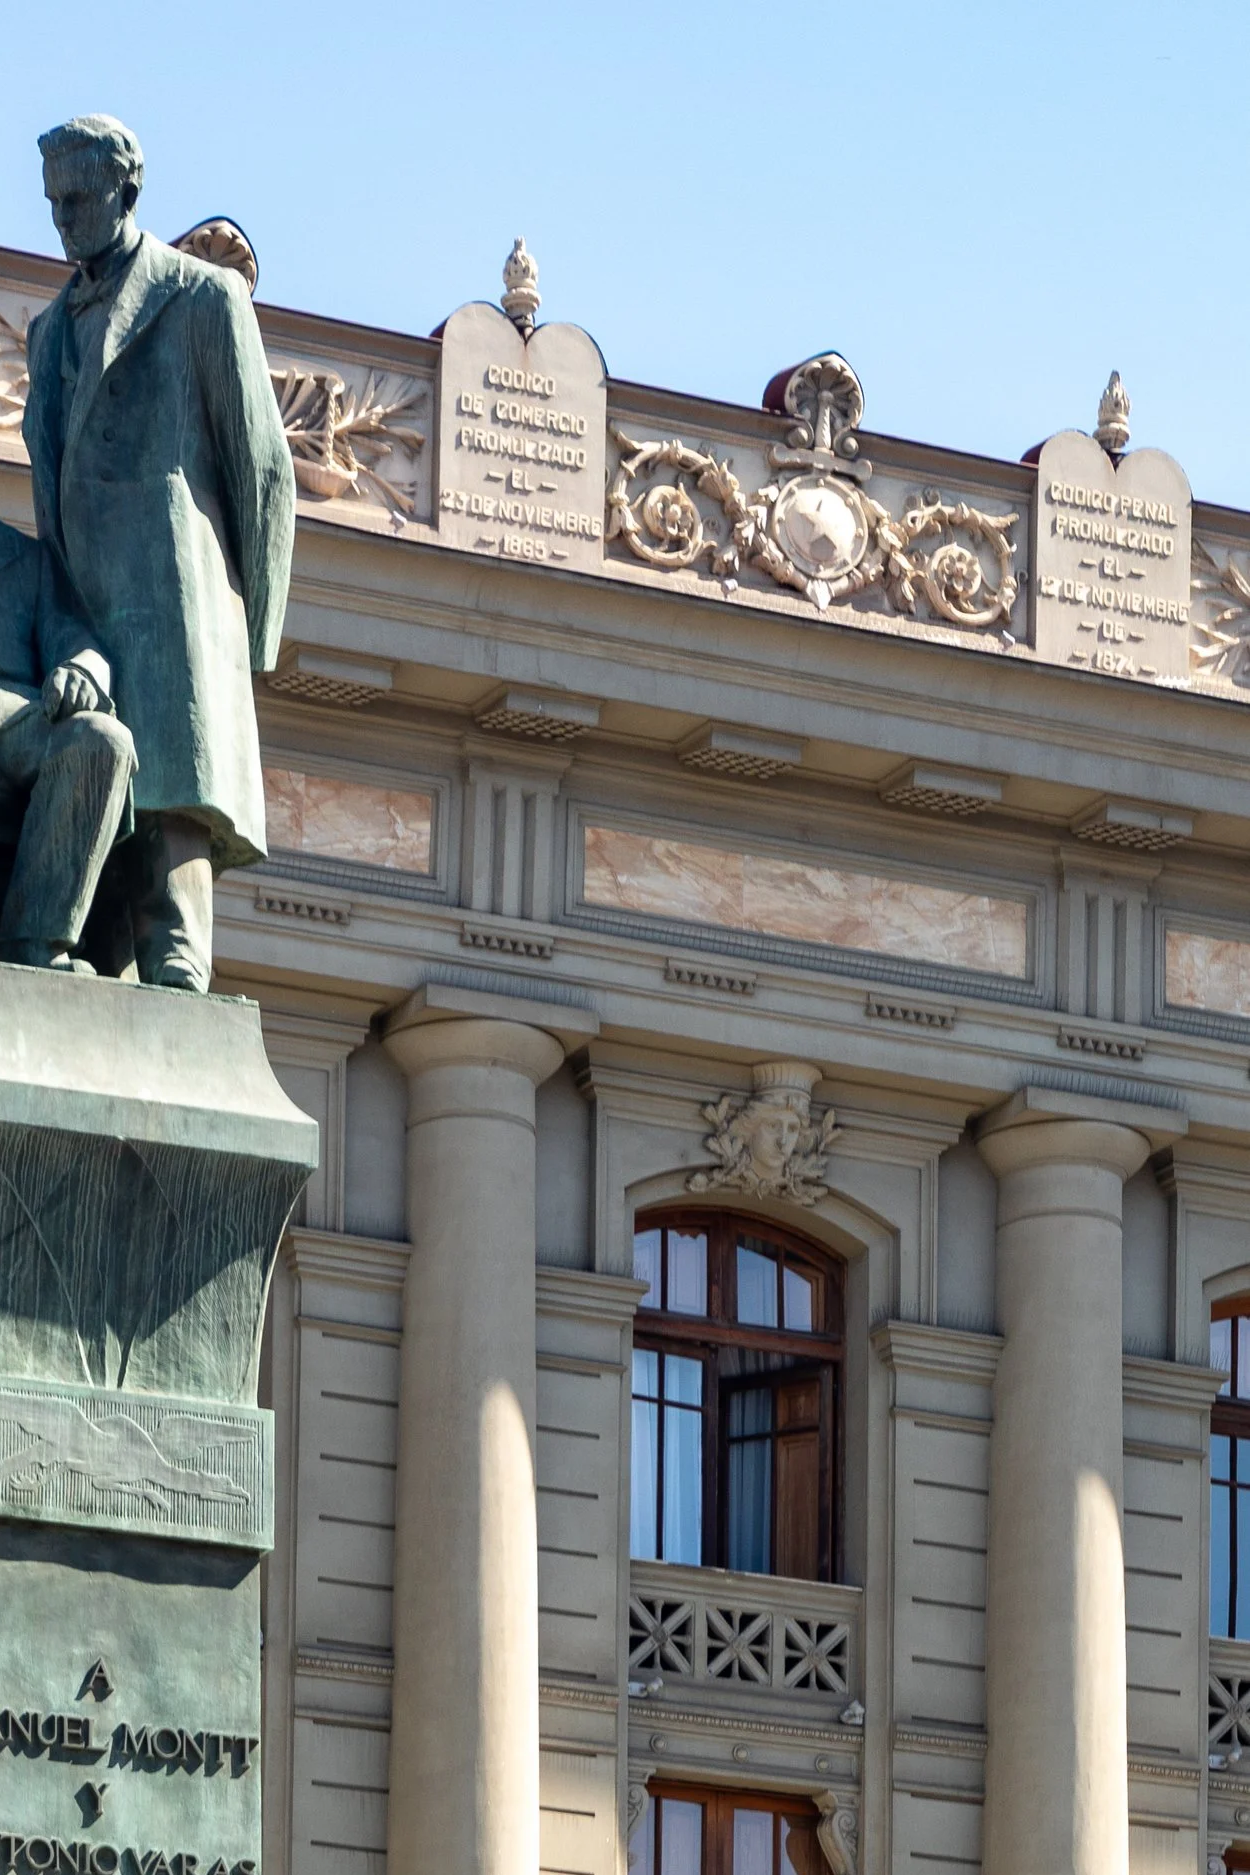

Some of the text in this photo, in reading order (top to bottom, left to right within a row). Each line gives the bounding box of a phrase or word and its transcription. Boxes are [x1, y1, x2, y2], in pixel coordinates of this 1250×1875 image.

[488, 364, 556, 397] CODIGO
[460, 392, 588, 436] DE COMERCIO
[460, 426, 587, 468] PROMULGADO
[511, 469, 535, 491] EL
[440, 488, 603, 537] 23 DE NOVIEMBRE
[1050, 481, 1178, 526] CODIGO PENAL
[503, 533, 546, 561] 1865
[1056, 515, 1175, 557] PROMULGADO
[1103, 557, 1126, 578] EL
[1063, 581, 1089, 602] DE
[1091, 585, 1190, 623] NOVIEMBRE
[1102, 620, 1126, 641] DE
[1095, 649, 1137, 675] 1874
[86, 1657, 115, 1695] A
[120, 1723, 259, 1768] MONTT
[84, 1781, 108, 1816] Y
